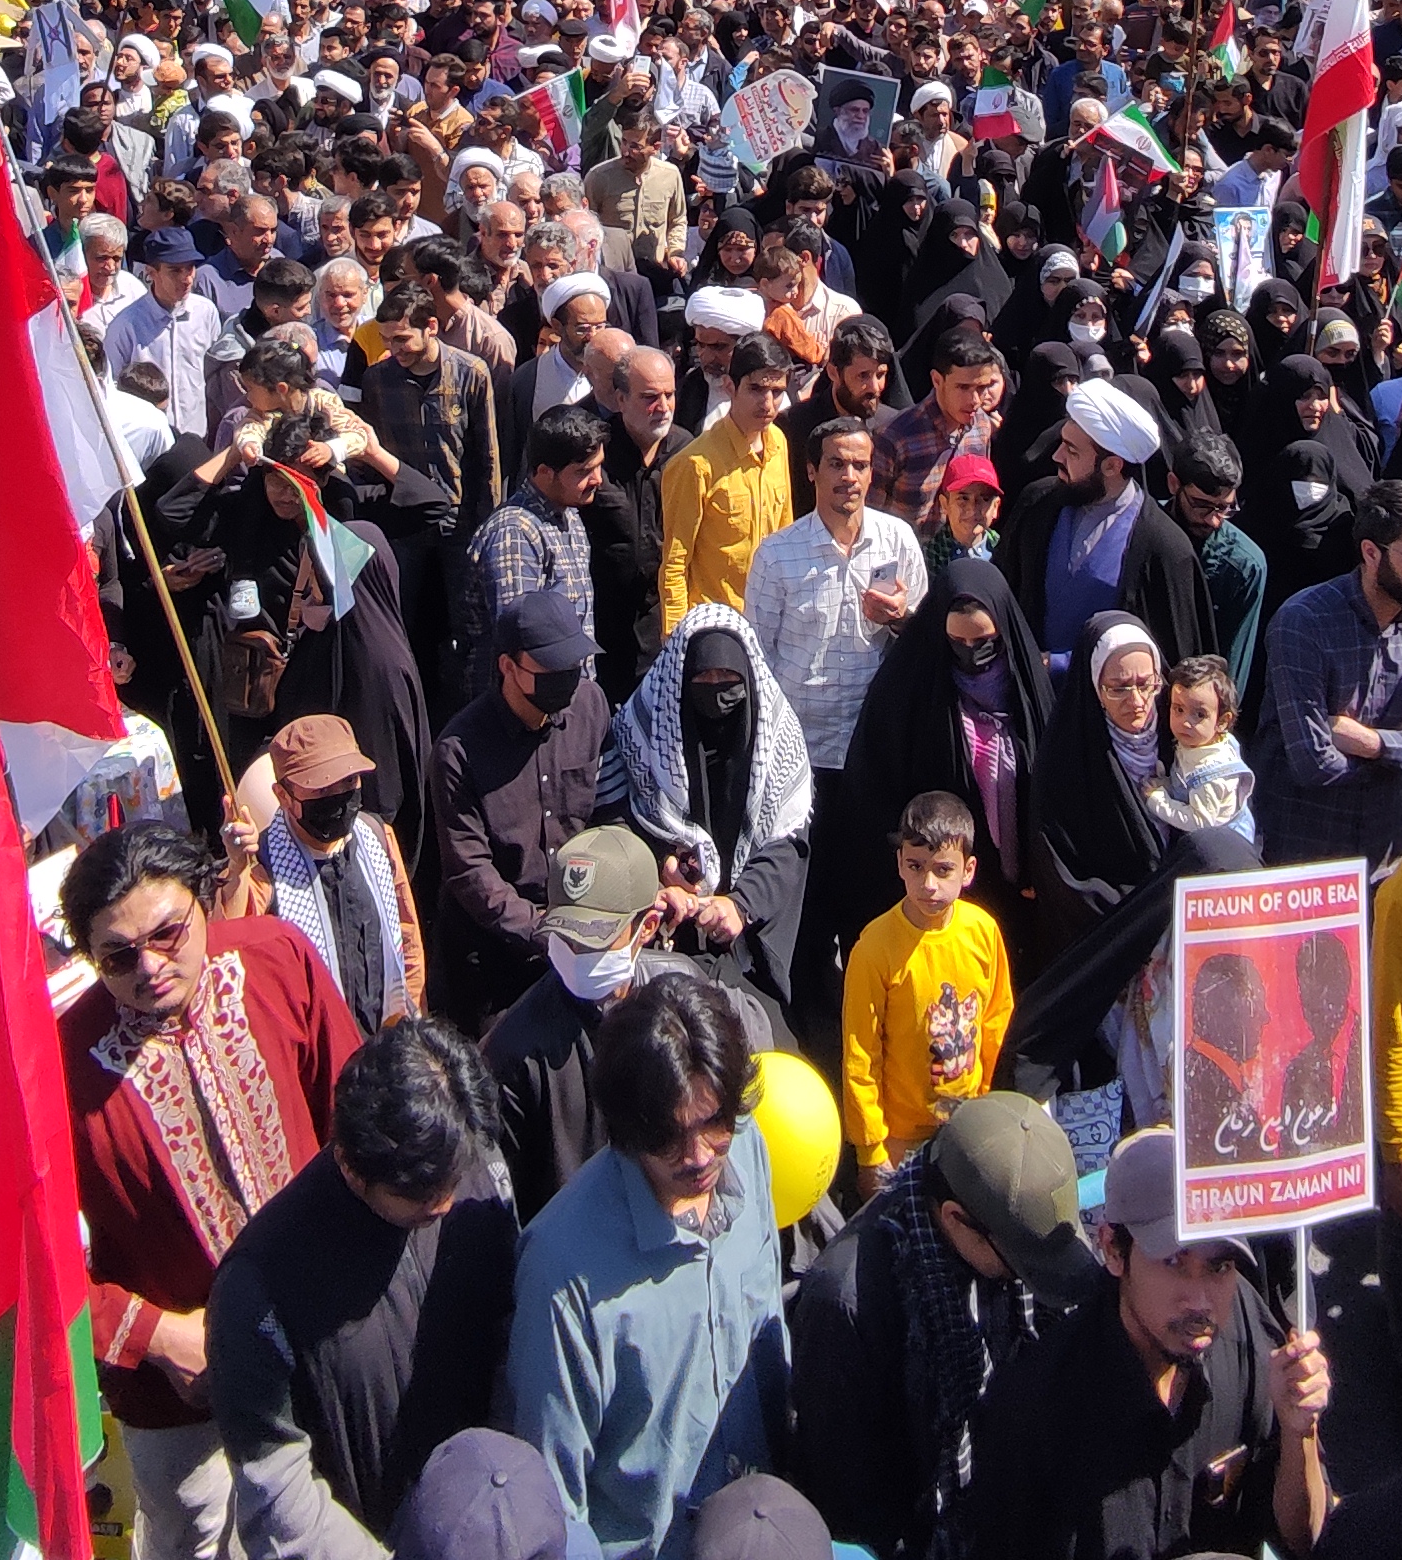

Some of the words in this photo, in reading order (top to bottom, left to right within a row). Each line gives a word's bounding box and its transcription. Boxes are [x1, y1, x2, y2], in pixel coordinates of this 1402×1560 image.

[1185, 893, 1255, 921] FIRAUN
[1258, 890, 1283, 914] OF
[1286, 885, 1324, 909] OUR
[1327, 881, 1358, 905] ERA
[1214, 1106, 1256, 1155] زمان
[1259, 1104, 1293, 1152] این
[1292, 1096, 1339, 1145] فرعون
[1190, 1182, 1264, 1212] FIRAUN
[1270, 1170, 1334, 1202] ZAMAN
[1337, 1164, 1362, 1188] INI
